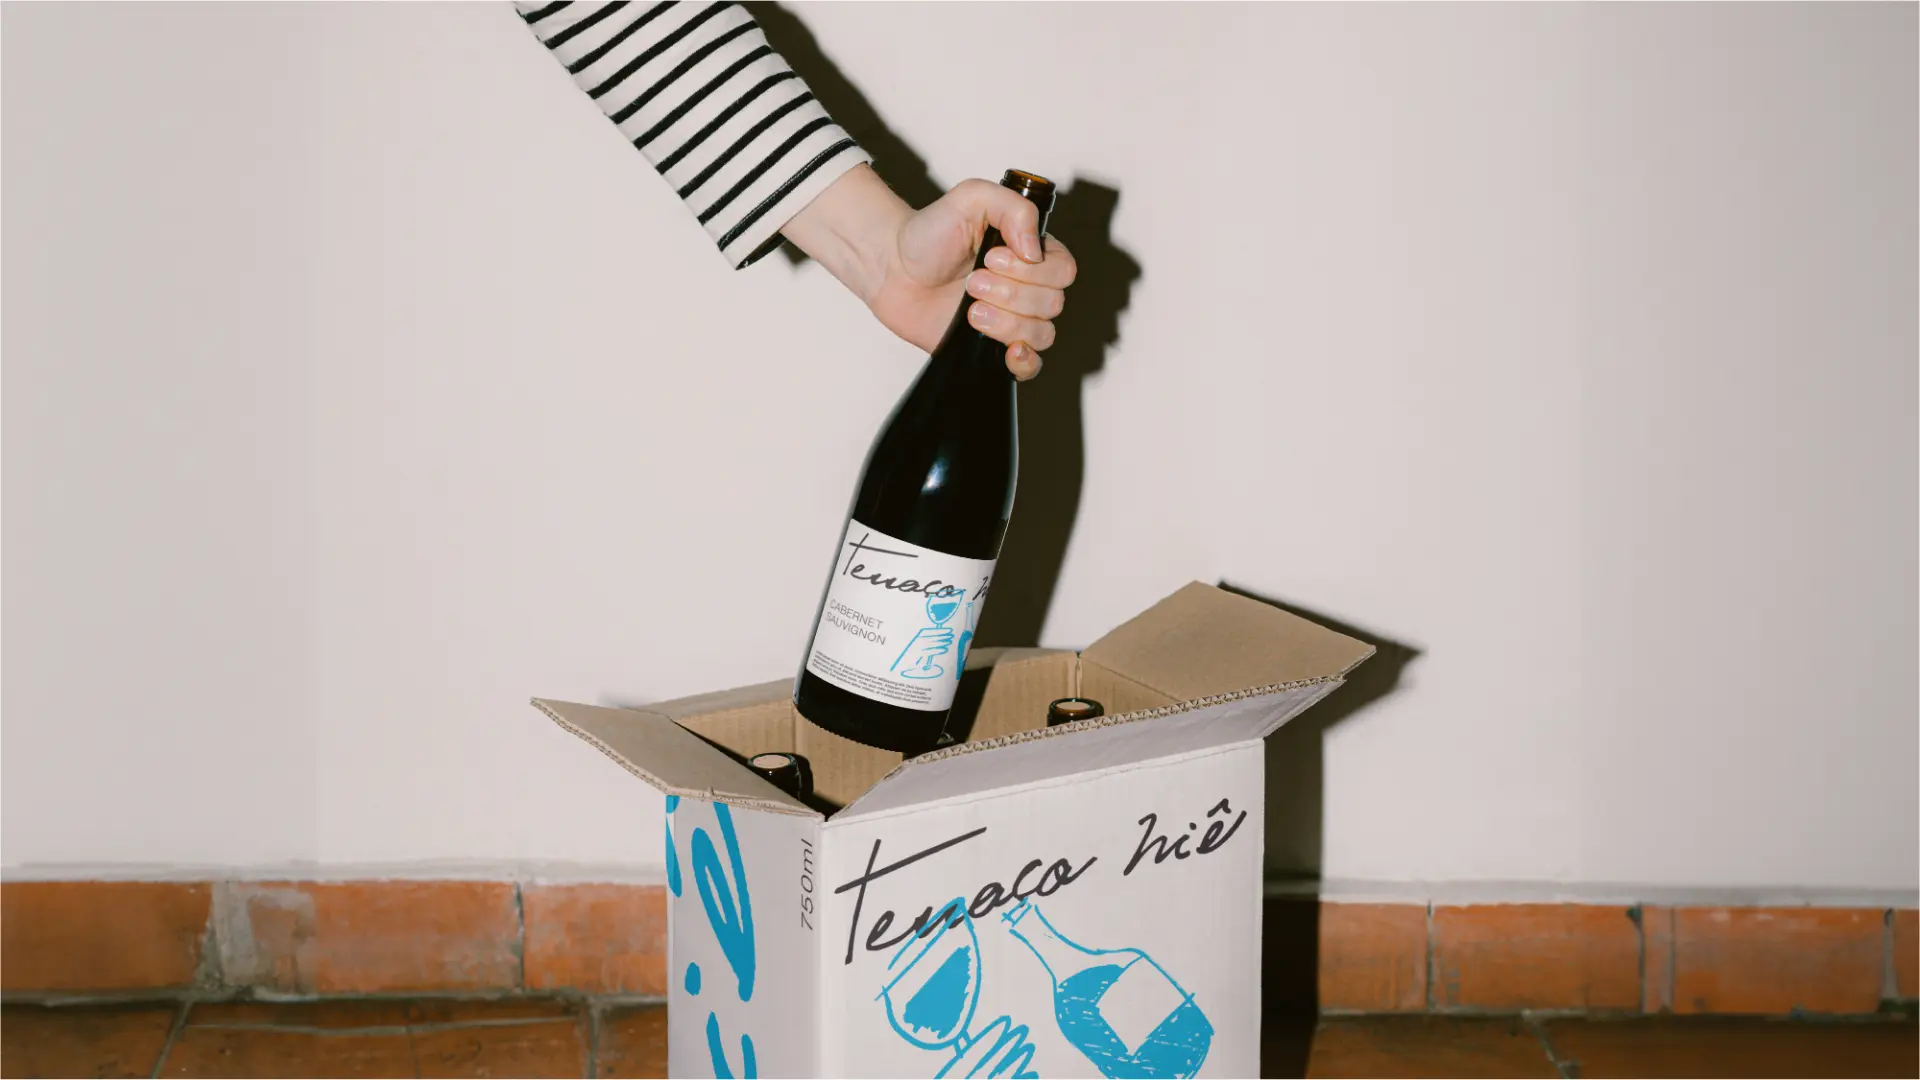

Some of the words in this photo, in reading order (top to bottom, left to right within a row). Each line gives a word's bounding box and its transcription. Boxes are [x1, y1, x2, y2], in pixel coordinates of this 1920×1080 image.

[825, 612, 887, 646] SAUVIGNON
[829, 598, 884, 630] CABERNET
[800, 838, 814, 931] 750ml
